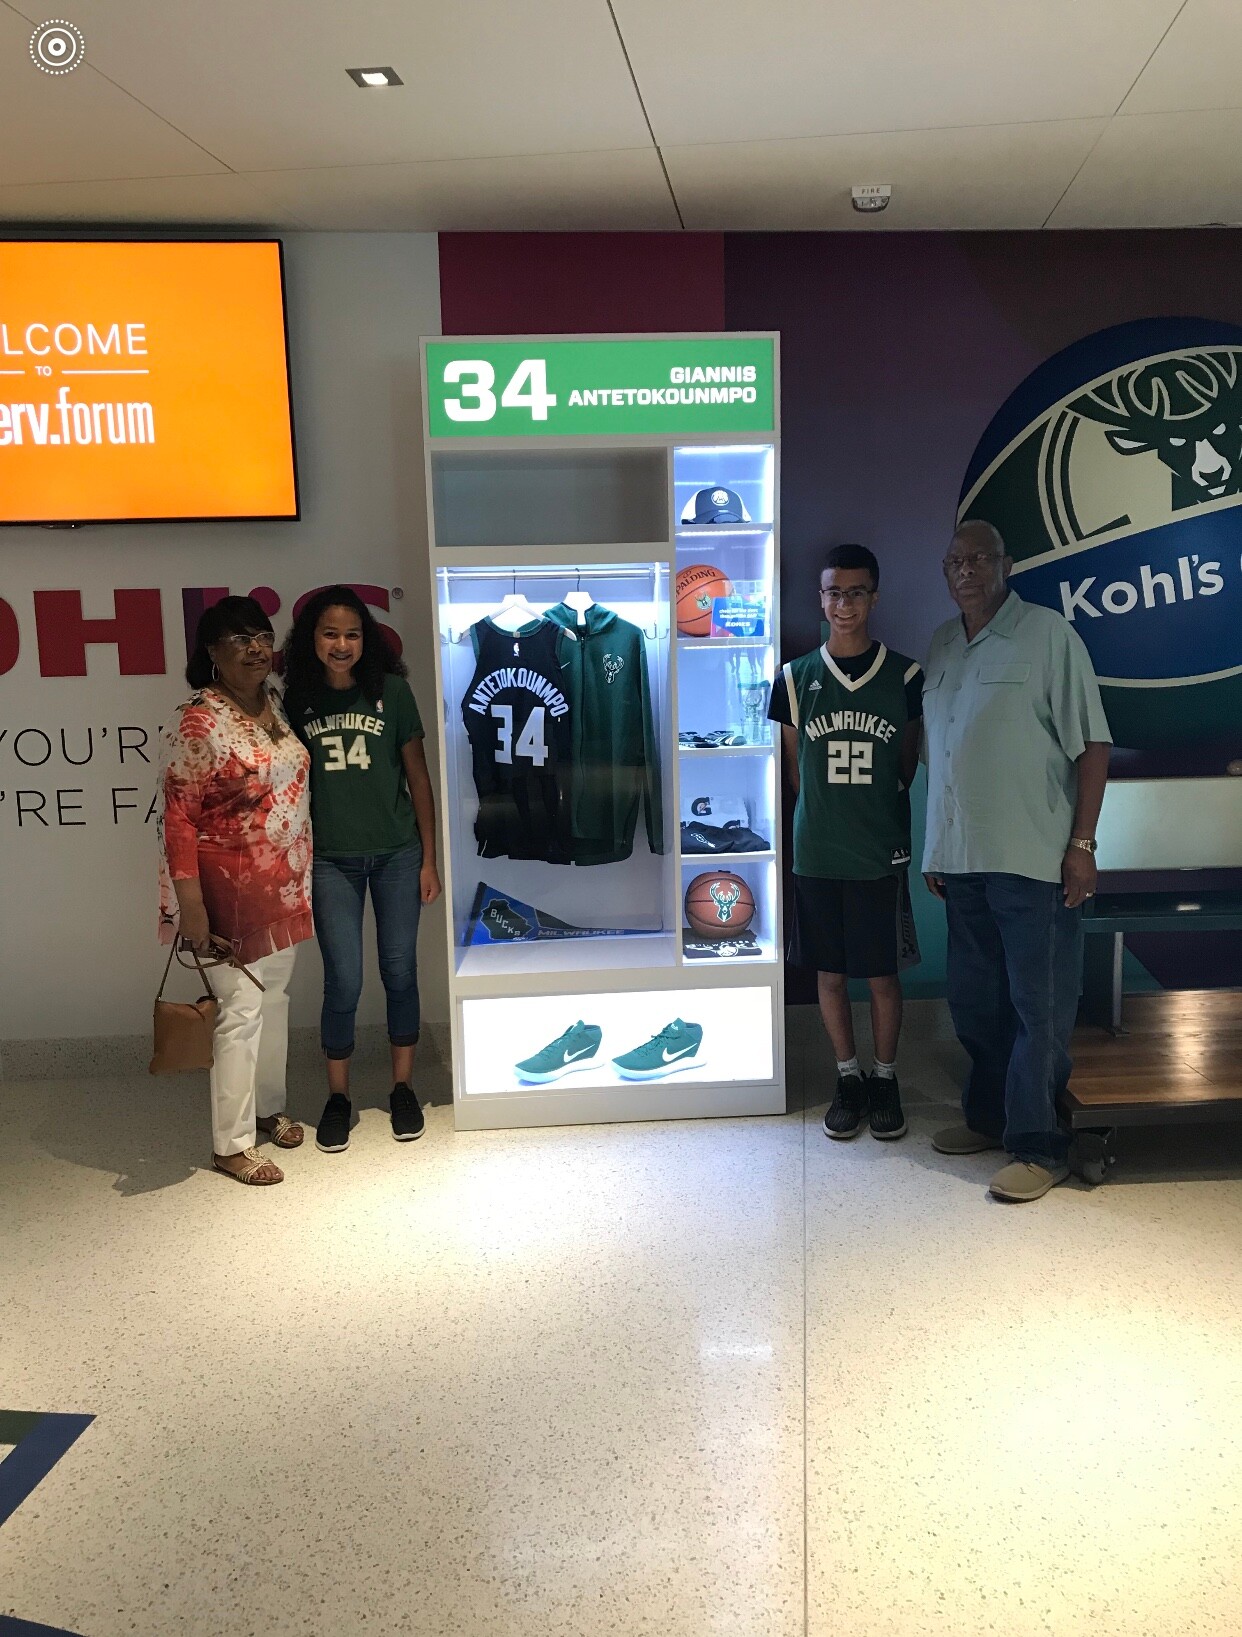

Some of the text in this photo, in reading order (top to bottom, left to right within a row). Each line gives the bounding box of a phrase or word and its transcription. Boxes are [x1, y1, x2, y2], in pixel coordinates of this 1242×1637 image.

[861, 187, 881, 195] FIRE
[35, 365, 53, 377] TO
[670, 365, 757, 384] GIANNIS
[443, 358, 557, 422] 34
[567, 386, 757, 407] ANTETOKOUNMPO
[676, 569, 716, 598] PALDING
[1059, 554, 1225, 622] Kohl's
[468, 666, 570, 718] ANTETOKOUNMPO
[303, 712, 386, 740] MILWAUKEE
[490, 704, 549, 767] 34
[804, 710, 897, 744] MILWAUKEE
[0, 725, 164, 767] OU'R
[321, 734, 372, 772] 34
[827, 740, 874, 785] 22
